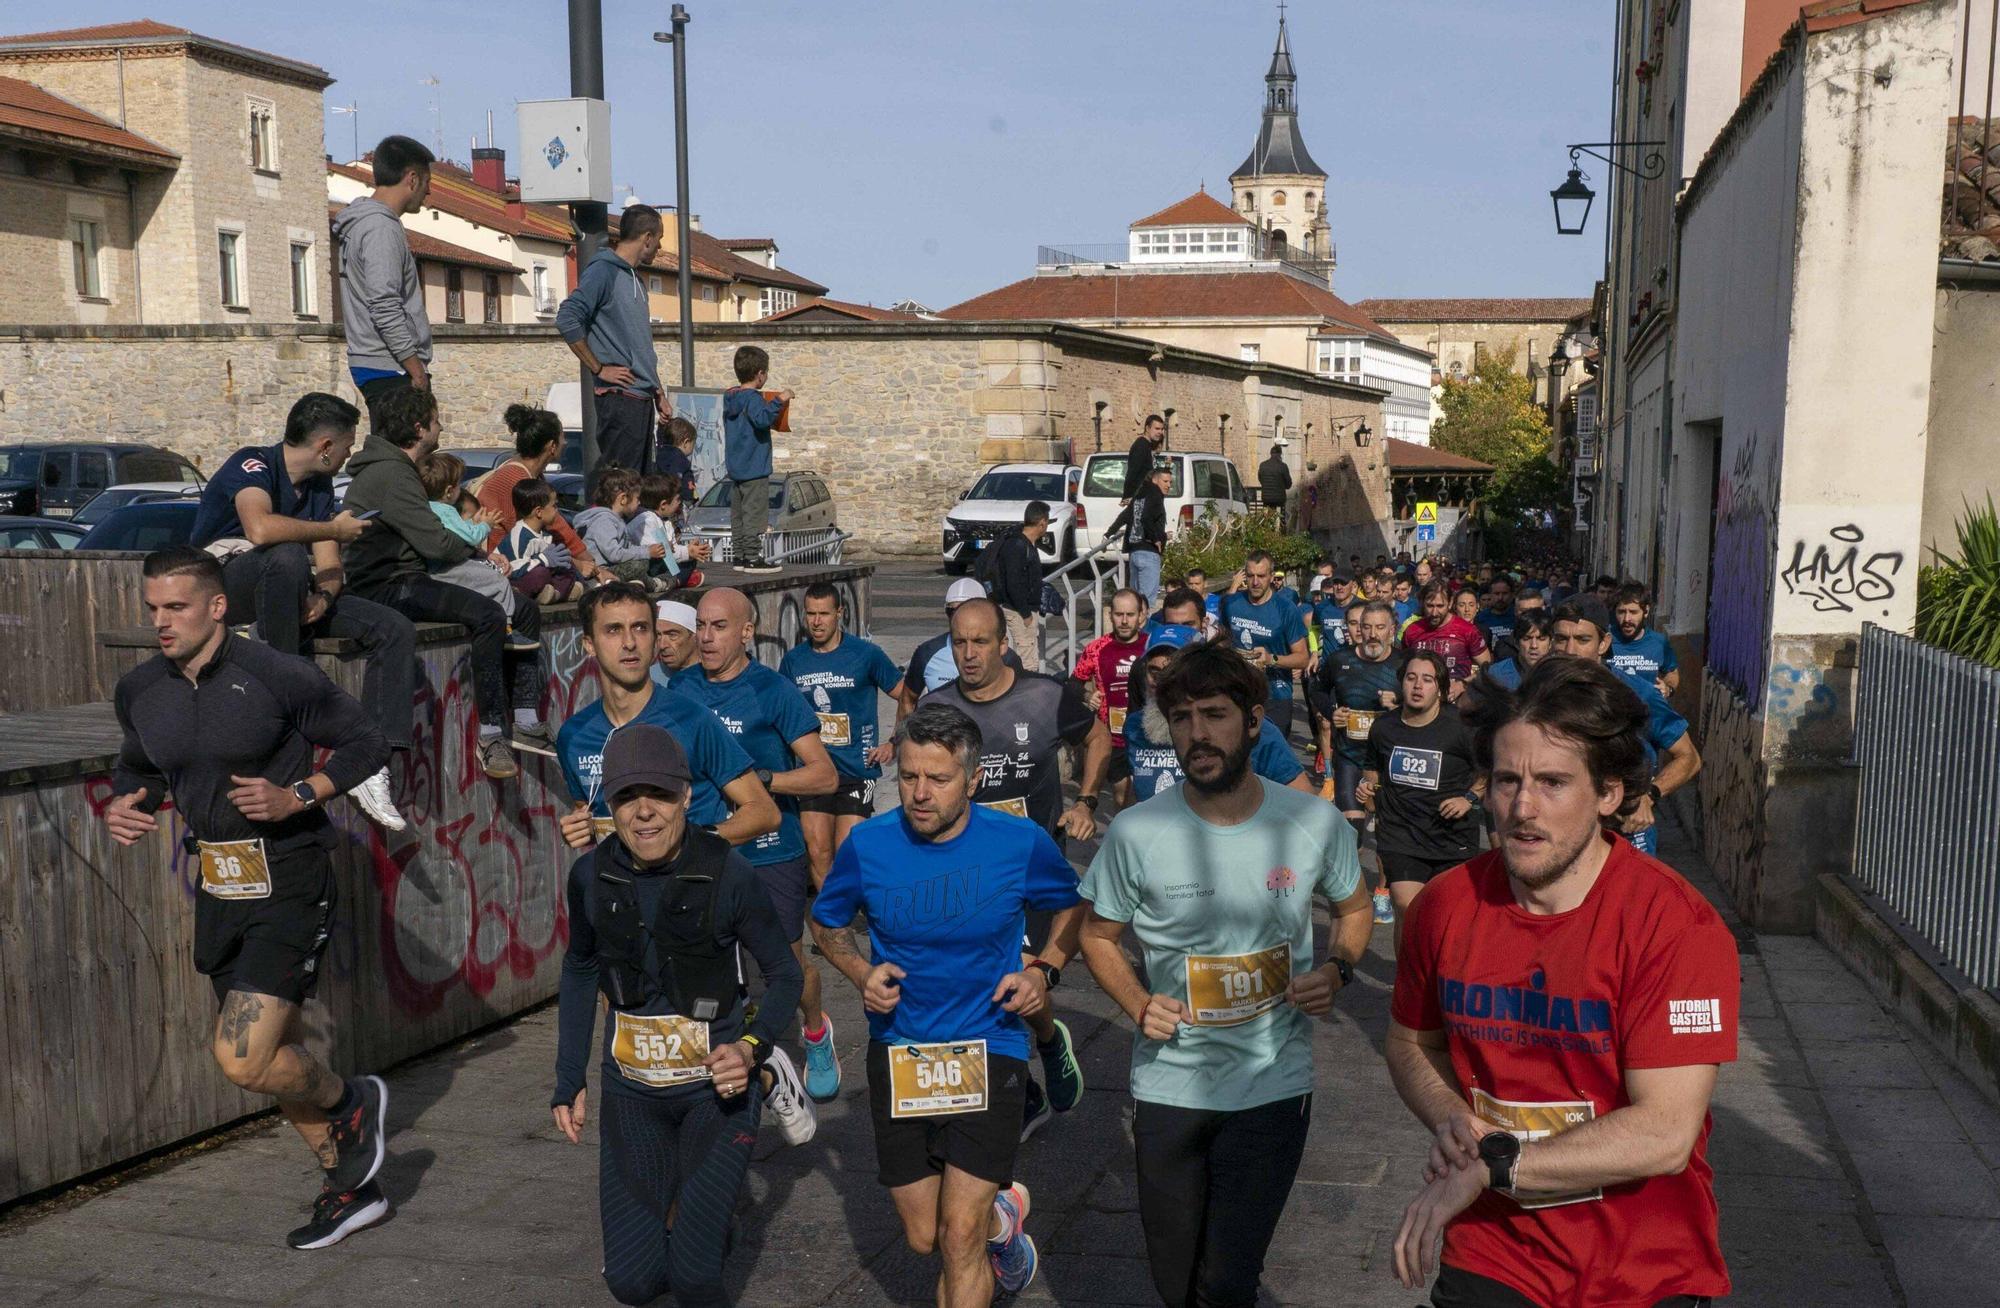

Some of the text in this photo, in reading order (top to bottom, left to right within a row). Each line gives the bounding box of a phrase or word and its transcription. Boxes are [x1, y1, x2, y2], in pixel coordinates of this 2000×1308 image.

[803, 675, 846, 687] ALMENDRA
[578, 756, 588, 765] LA
[1402, 757, 1427, 774] 923
[214, 856, 241, 879] 36
[883, 864, 981, 932] RUN
[1272, 950, 1285, 961] 10K
[1219, 967, 1263, 1000] 191
[1438, 971, 1611, 1033] IRONMAN
[1669, 999, 1711, 1013] VITORIA
[687, 1021, 702, 1030] 10K
[1669, 1012, 1712, 1026] GASTEIZ
[633, 1034, 683, 1061] 552
[967, 1047, 980, 1056] 10K
[649, 1062, 671, 1070] ALICIA
[916, 1060, 962, 1089] 546
[1565, 1112, 1585, 1123] 10K
